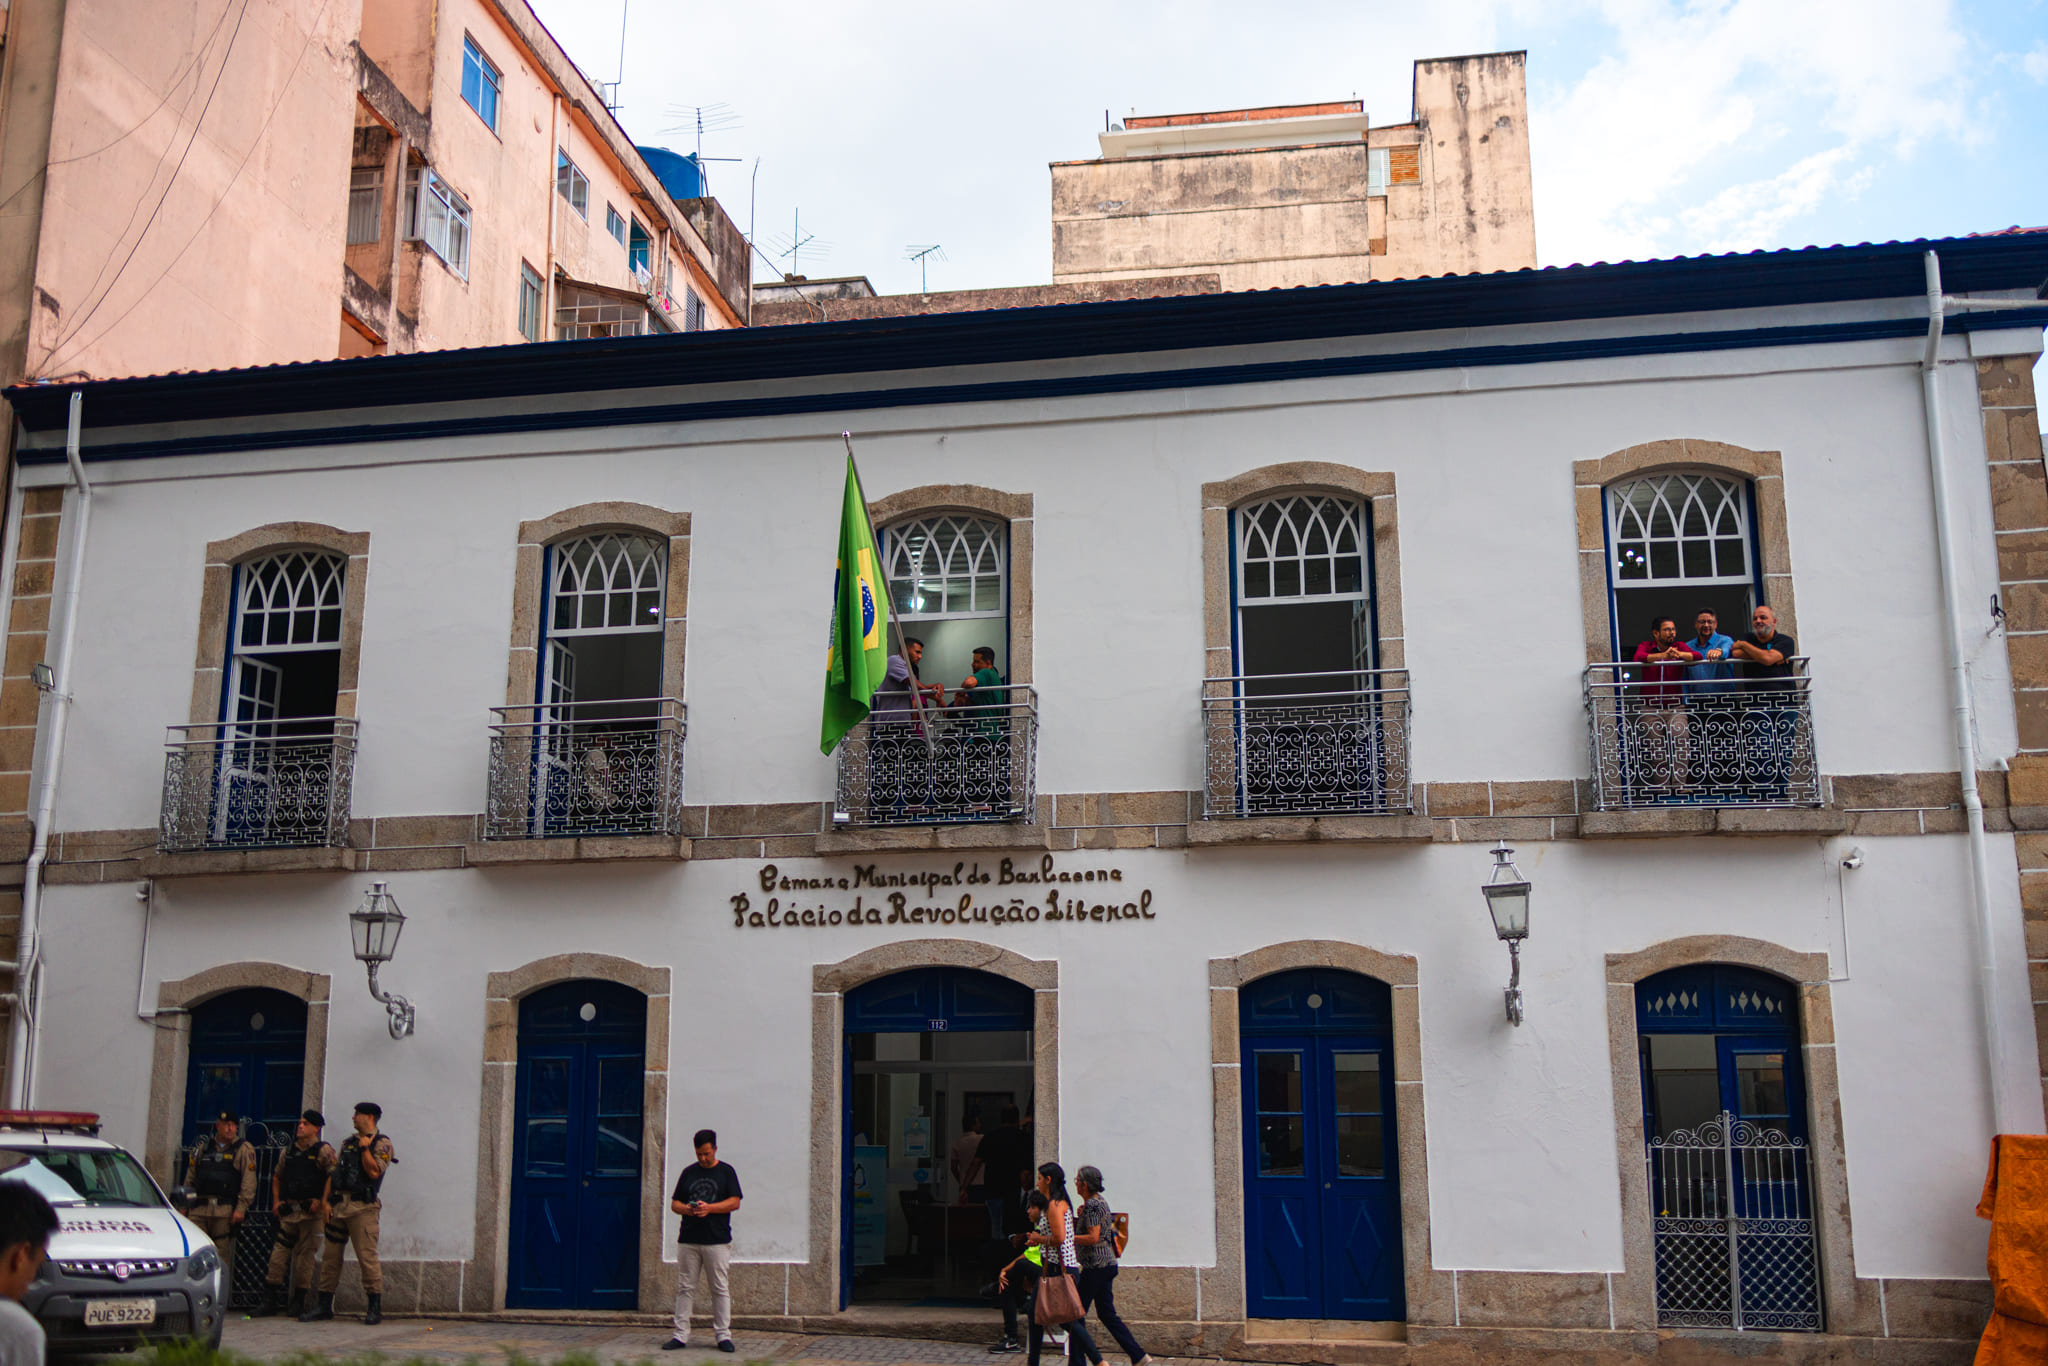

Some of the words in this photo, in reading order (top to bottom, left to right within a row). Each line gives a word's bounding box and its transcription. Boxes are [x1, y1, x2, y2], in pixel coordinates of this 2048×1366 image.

[760, 864, 849, 892] Câmara
[854, 862, 963, 898] Municipal
[967, 863, 991, 884] de
[999, 854, 1122, 885] Barbacena
[730, 892, 842, 928] Palácio
[847, 896, 882, 925] da
[887, 891, 1040, 926] Revolução
[1045, 889, 1156, 922] Liberal
[930, 1021, 945, 1030] 112
[117, 1308, 151, 1321] 9222
